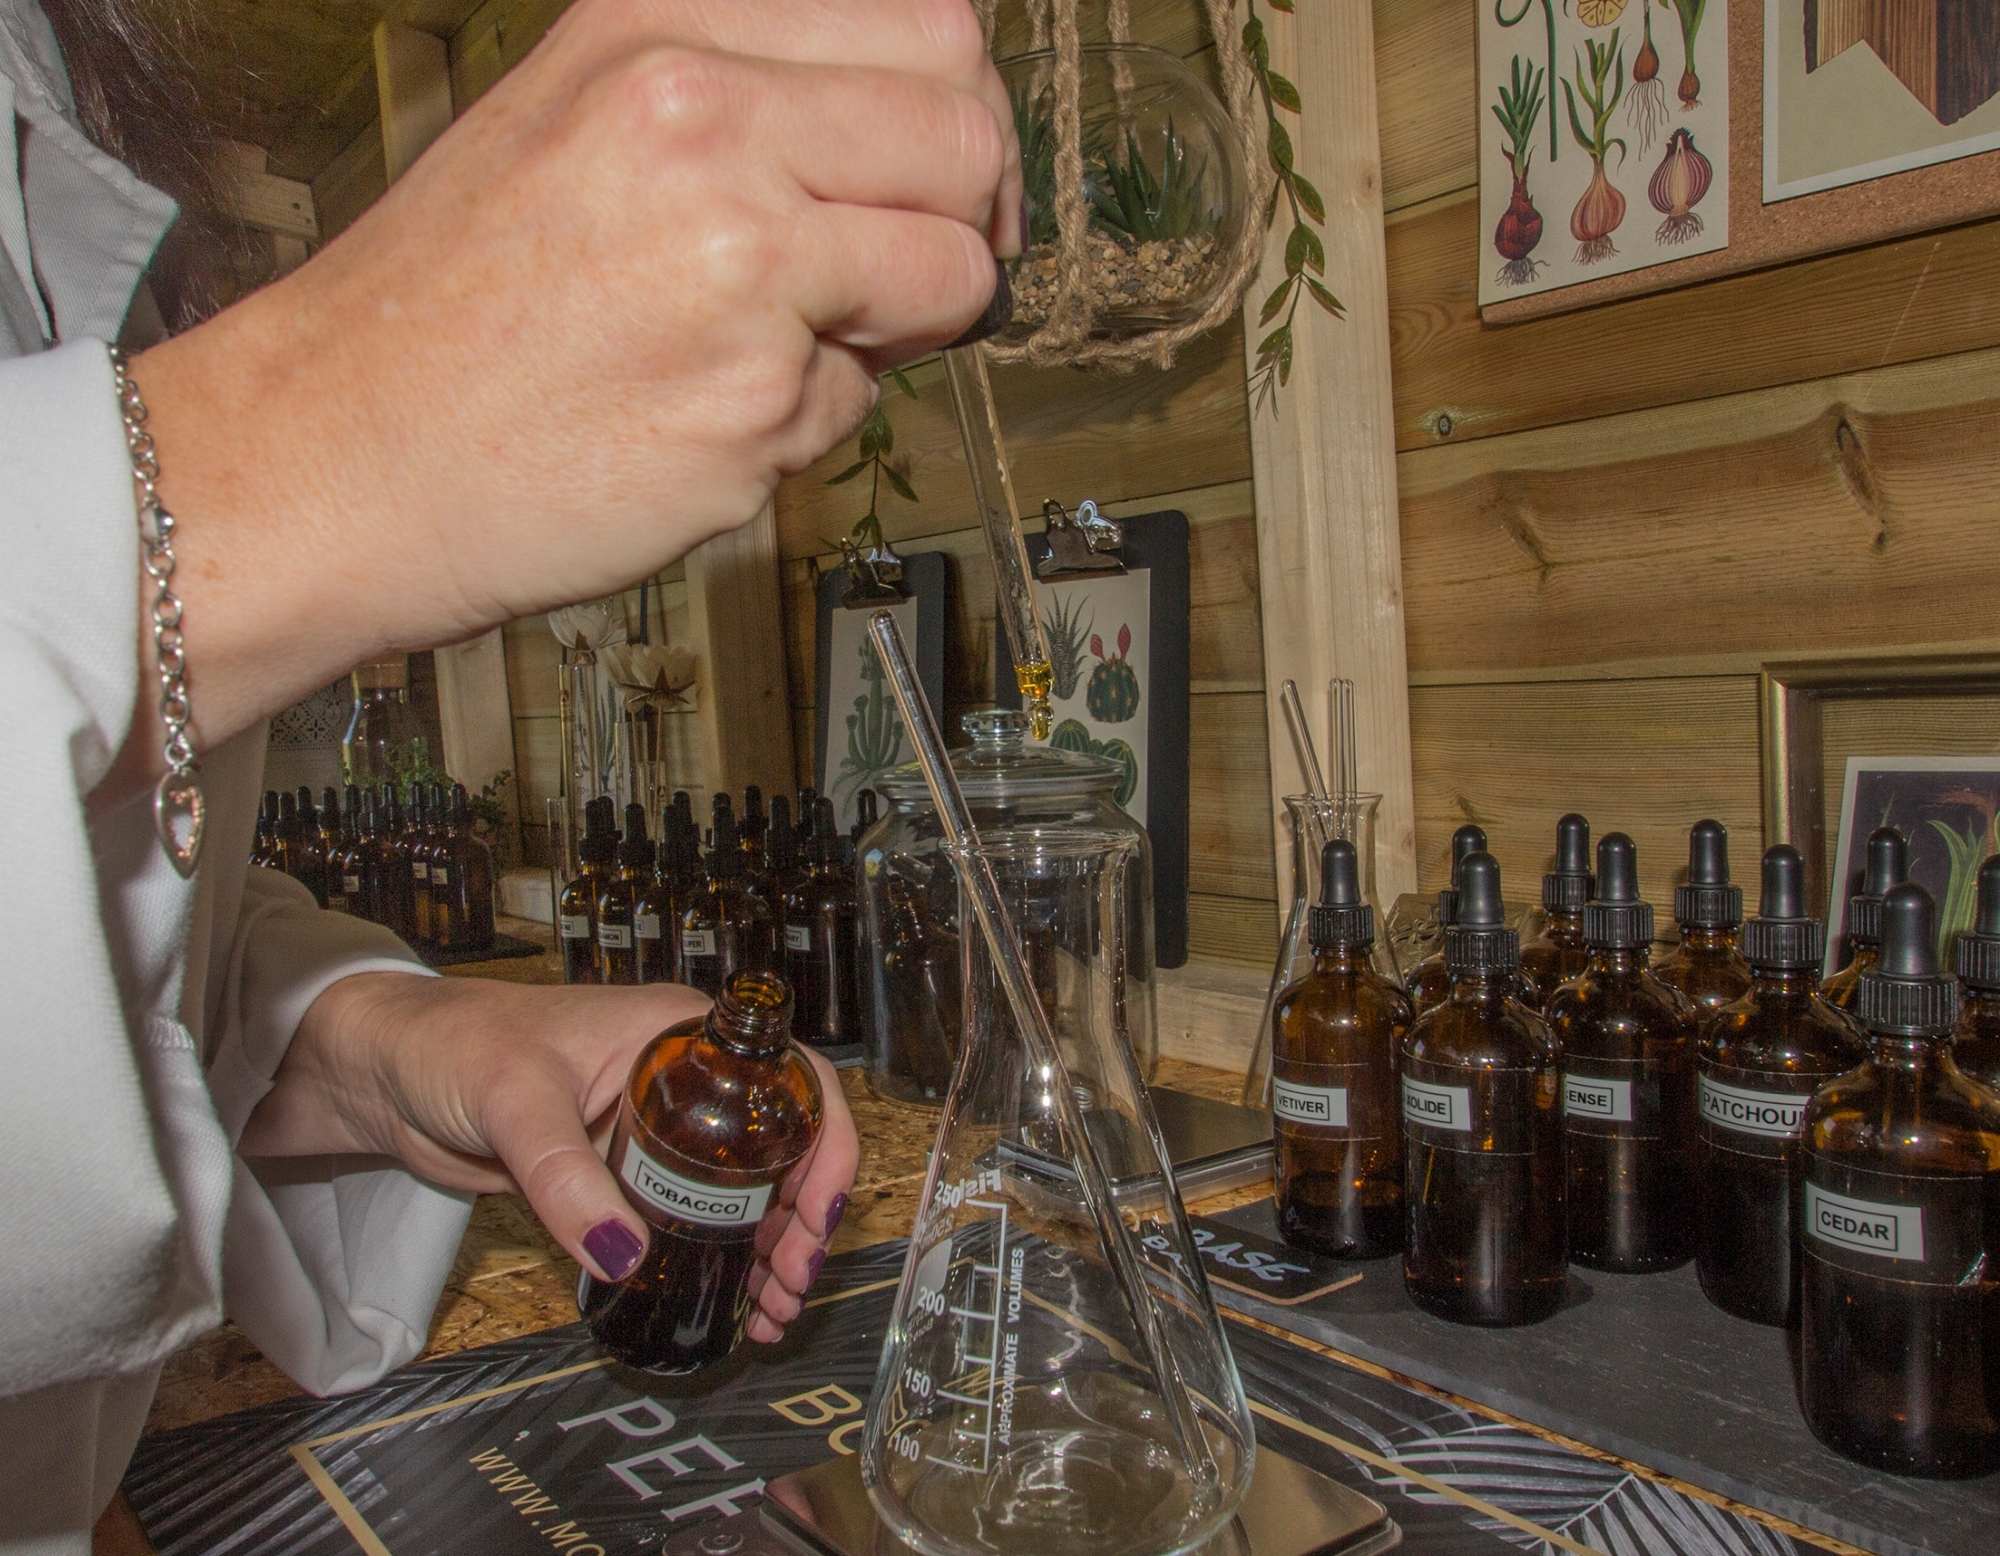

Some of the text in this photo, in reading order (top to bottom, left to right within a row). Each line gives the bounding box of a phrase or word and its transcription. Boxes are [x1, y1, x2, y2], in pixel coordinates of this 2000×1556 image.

[1277, 1093, 1325, 1114] VETIVER
[643, 1172, 740, 1215] TOBACCO
[935, 1180, 961, 1208] 250
[1820, 1210, 1890, 1241] CEDAR
[919, 1286, 945, 1316] 200
[999, 1248, 1024, 1446] APPROXIMATE VOLUMES
[904, 1366, 931, 1397] 150
[893, 1433, 920, 1462] 100
